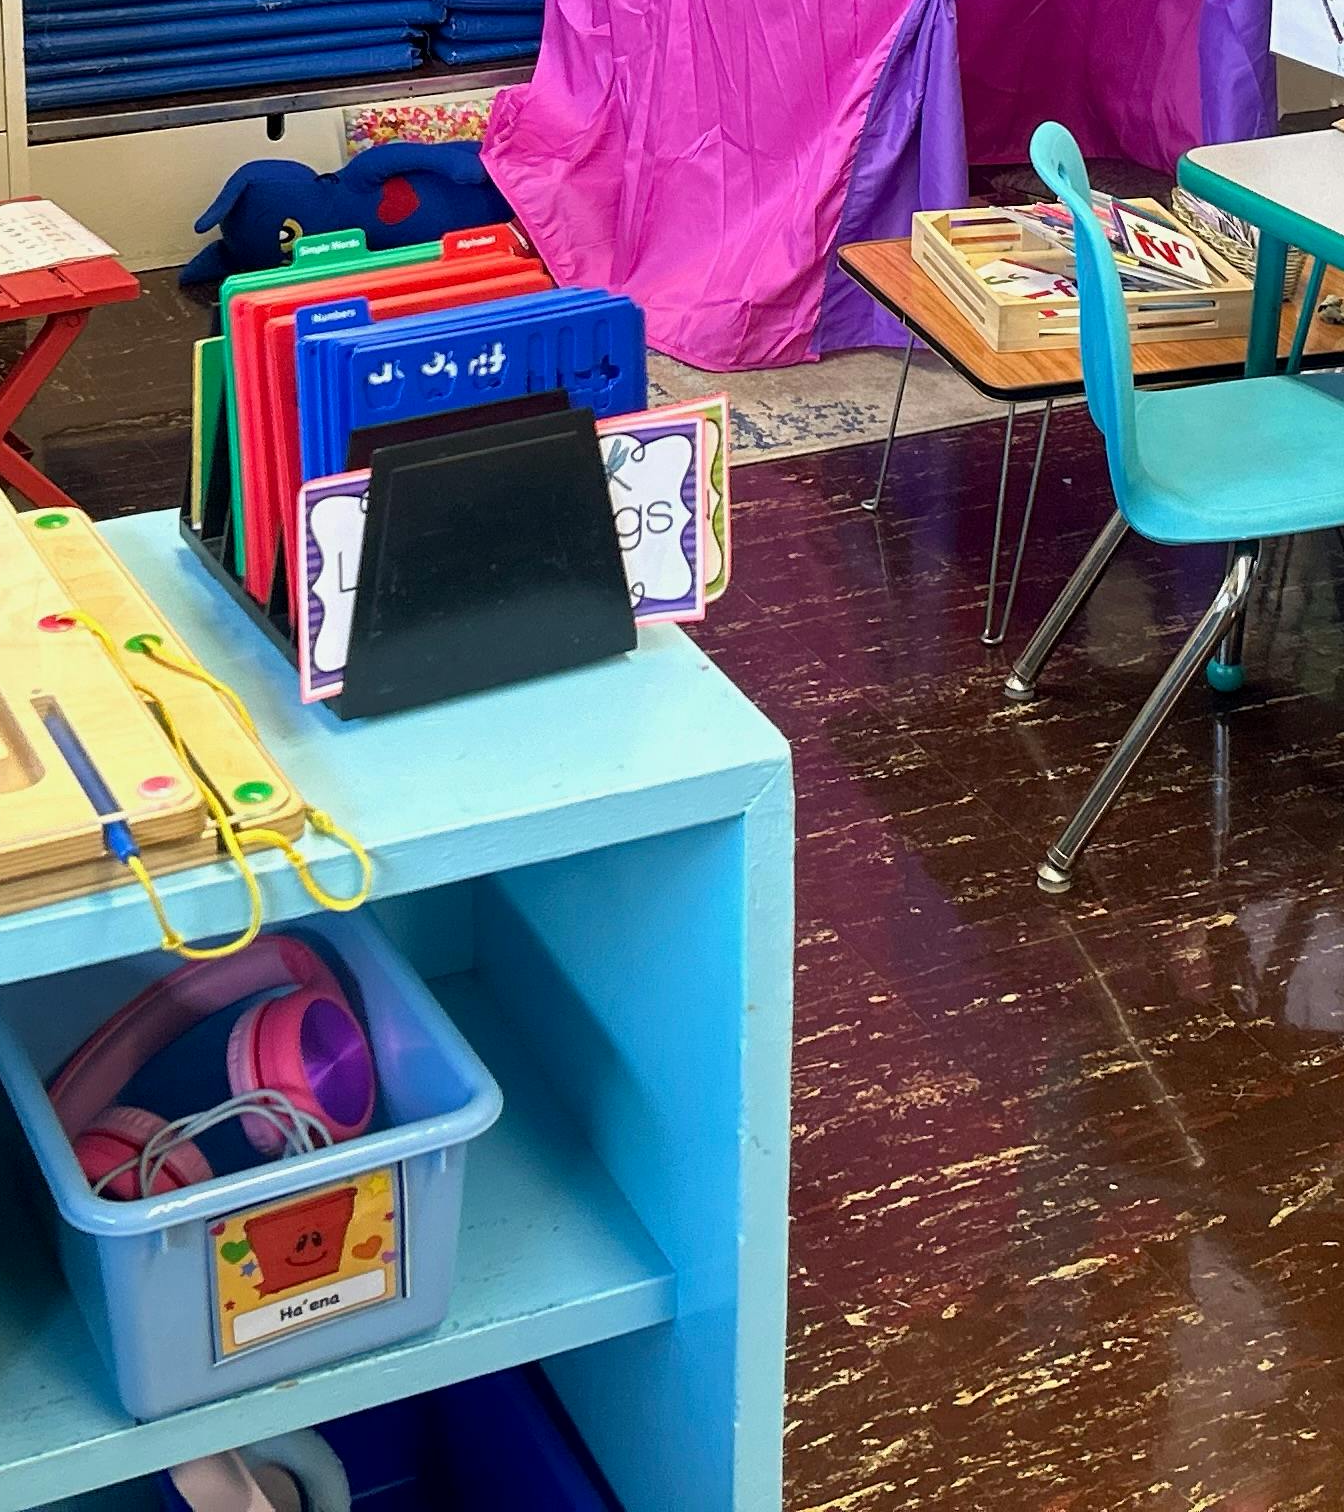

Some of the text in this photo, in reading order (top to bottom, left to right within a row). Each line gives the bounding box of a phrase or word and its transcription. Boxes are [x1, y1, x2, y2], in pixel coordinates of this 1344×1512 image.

[298, 238, 361, 257] Simple Words
[457, 235, 497, 249] Alphabet
[311, 308, 357, 324] Numbers
